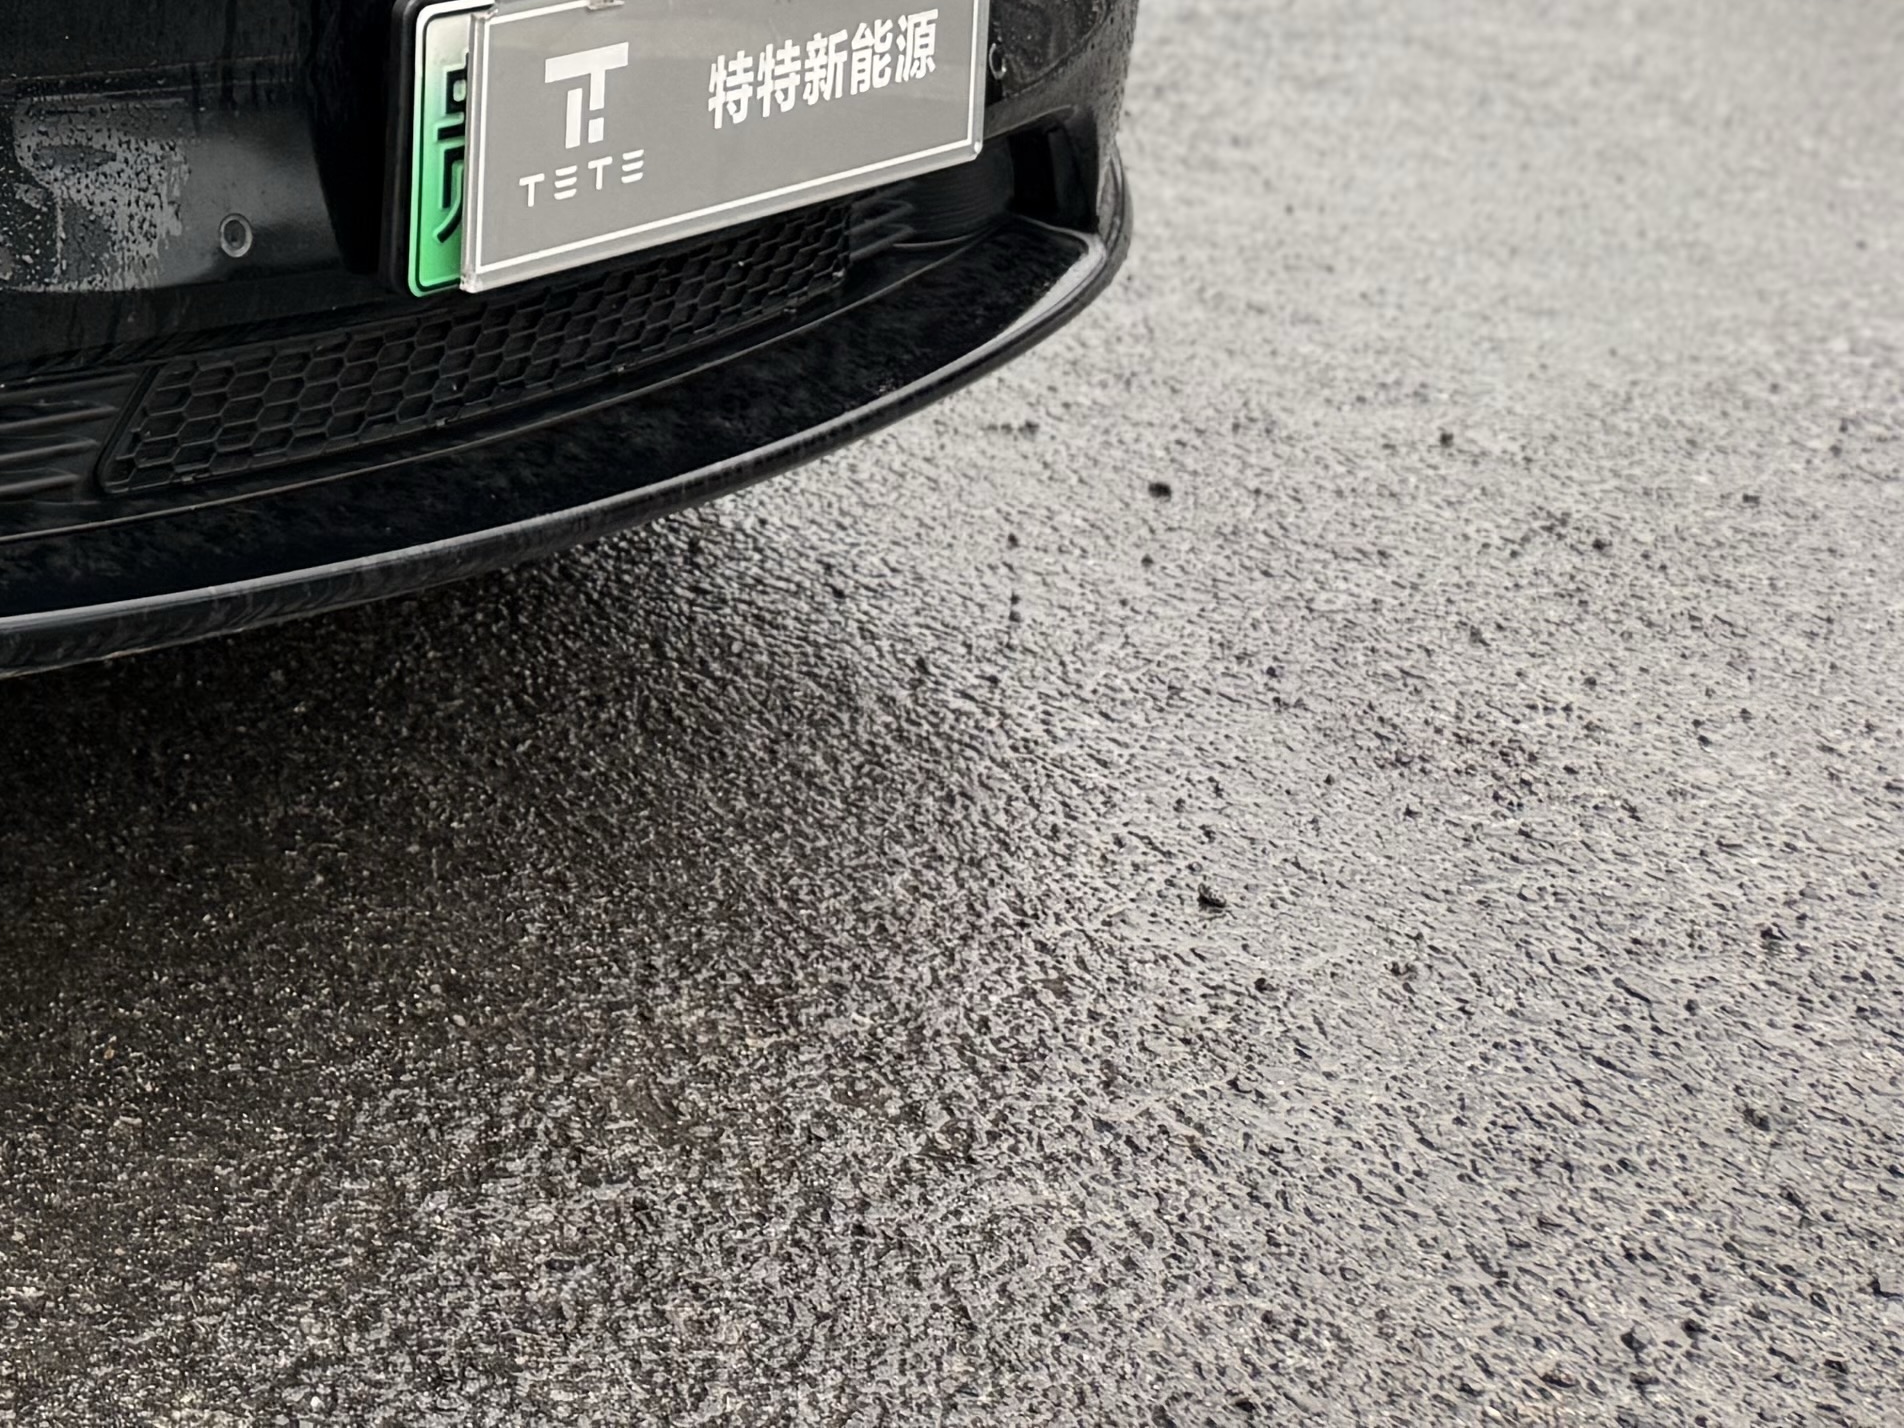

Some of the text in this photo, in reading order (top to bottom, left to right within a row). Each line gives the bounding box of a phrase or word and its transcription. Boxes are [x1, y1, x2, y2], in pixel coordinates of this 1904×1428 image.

[707, 8, 939, 130] 特特新能源
[518, 148, 645, 207] TETE
